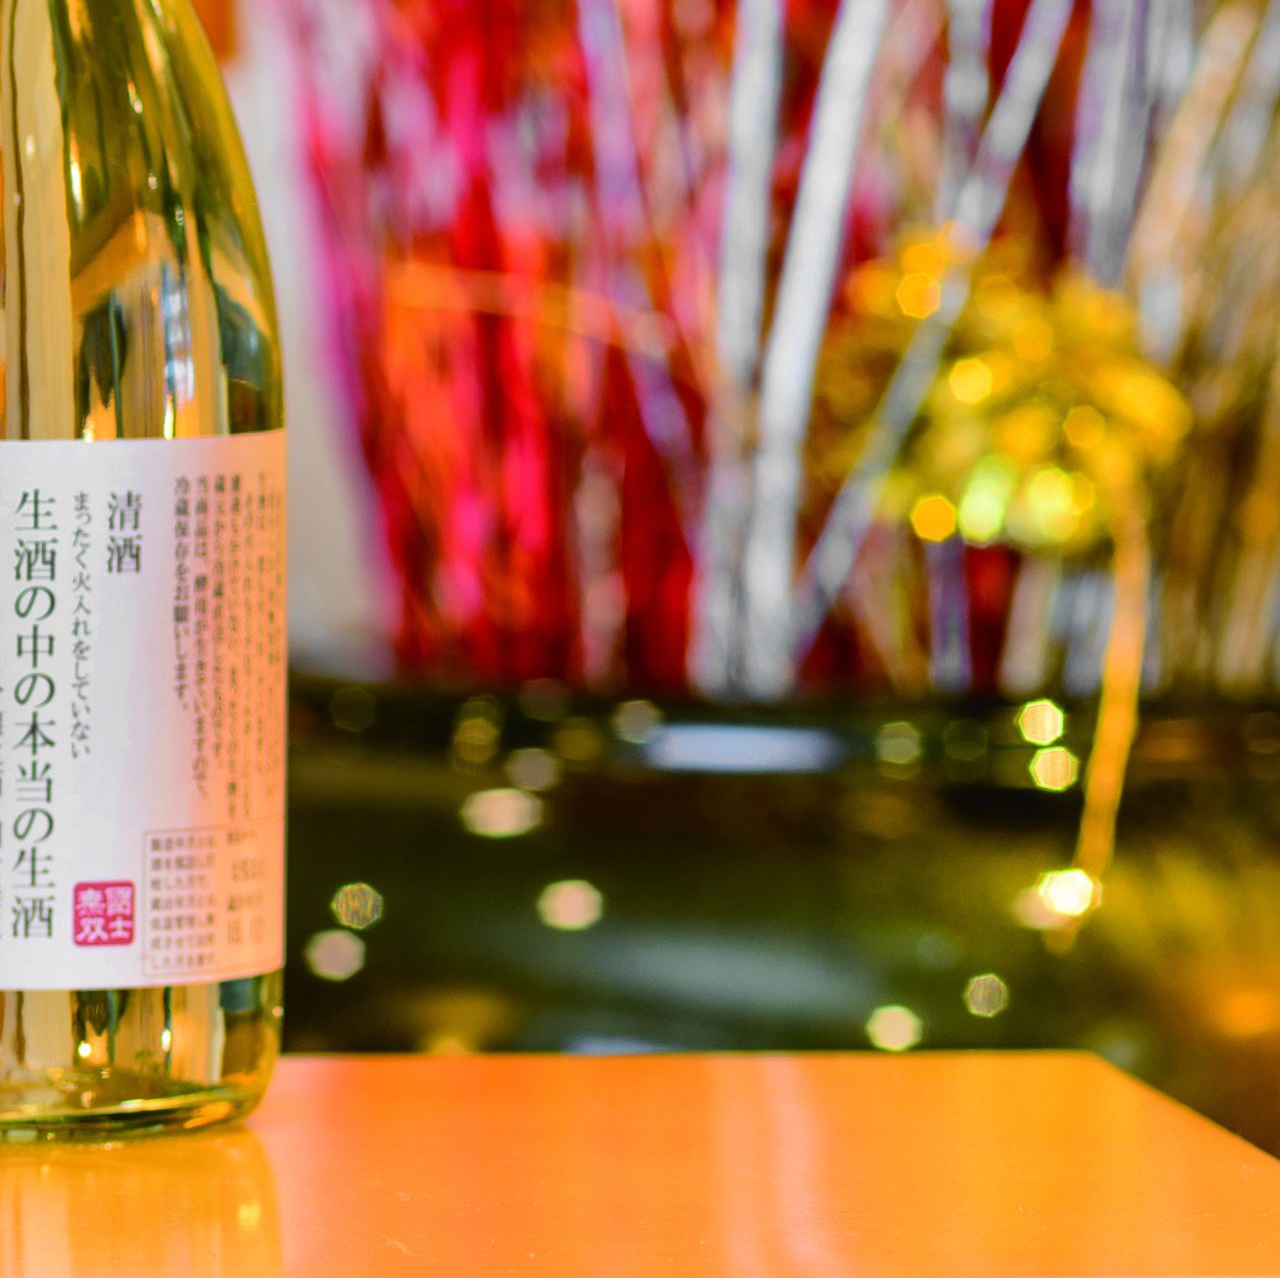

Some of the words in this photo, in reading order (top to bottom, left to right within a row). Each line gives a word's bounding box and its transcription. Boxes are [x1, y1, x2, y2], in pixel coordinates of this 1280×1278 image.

[70, 492, 92, 759] まったく火入れをしていない
[107, 490, 142, 574] 清酒
[11, 488, 58, 938] 生酒の中の本当の生酒
